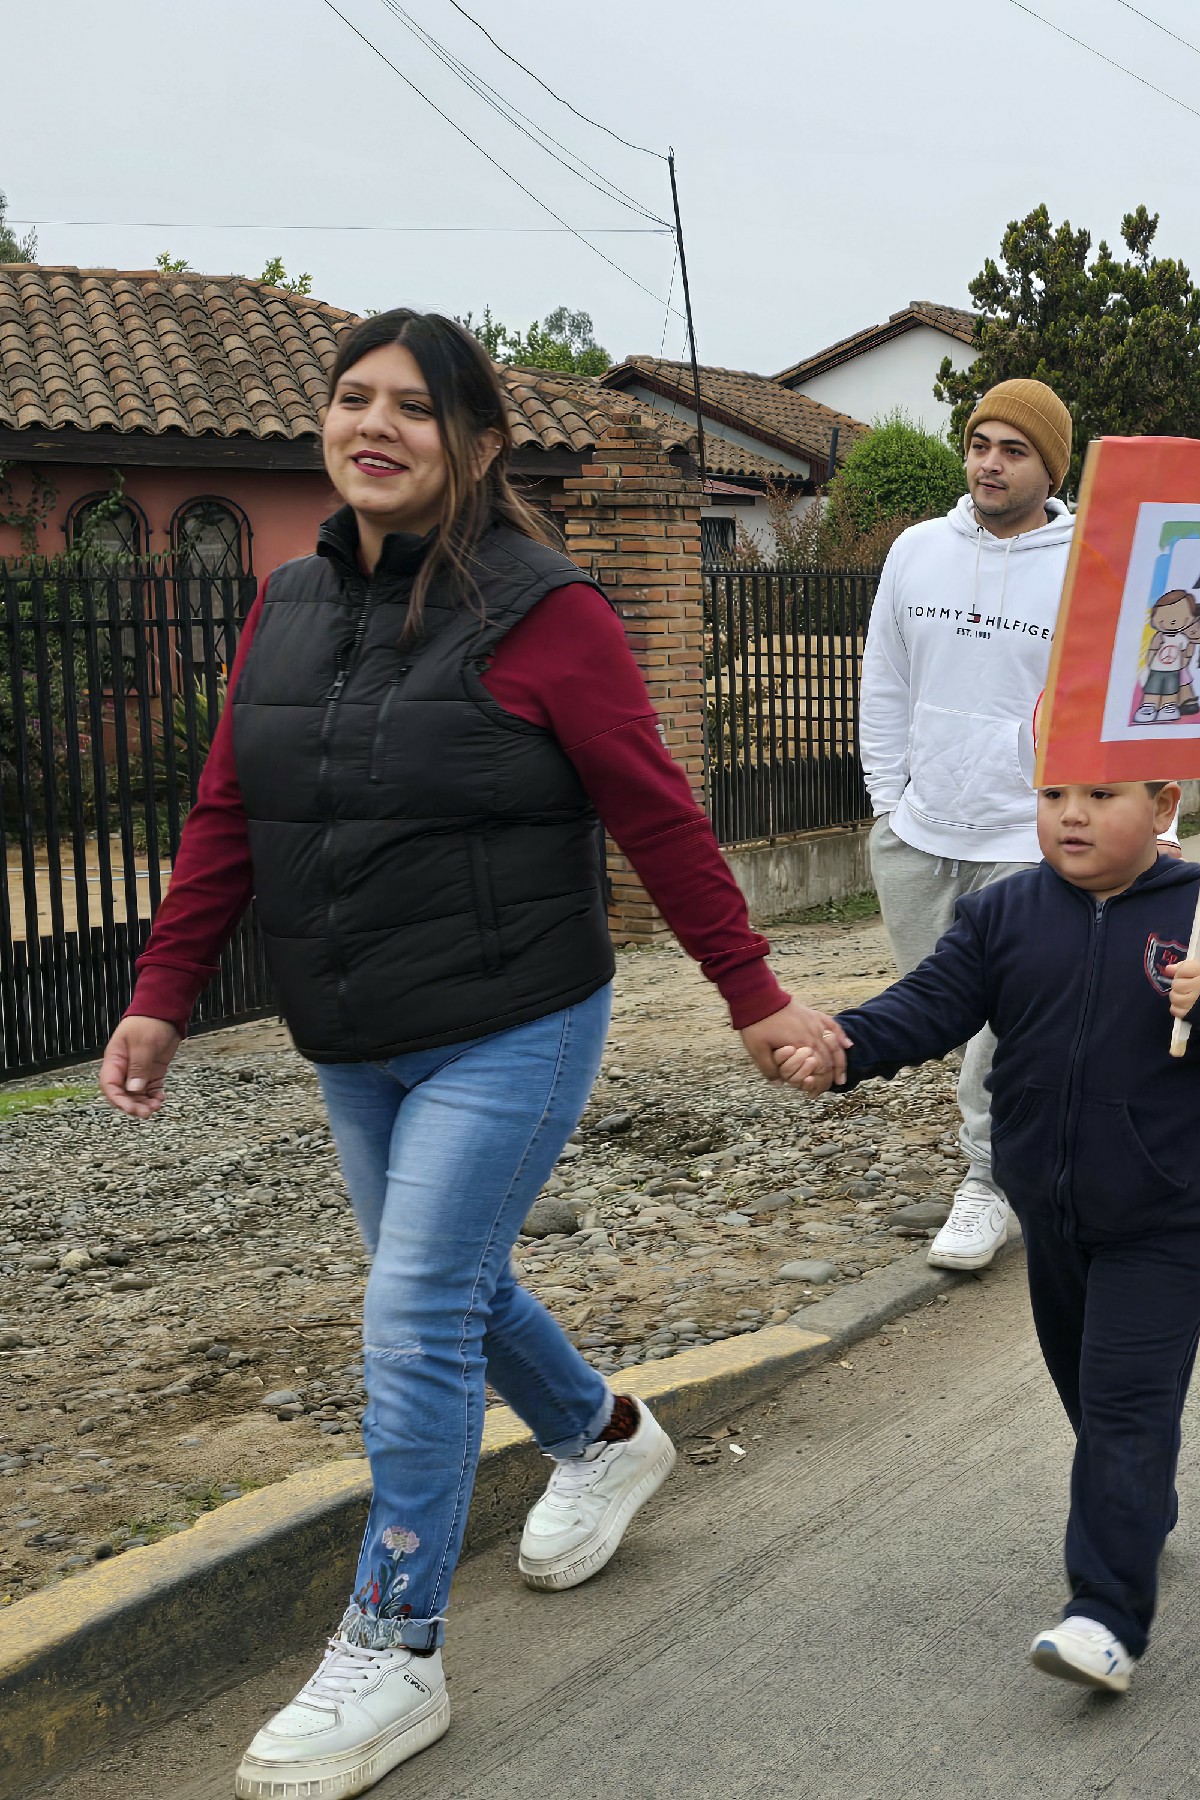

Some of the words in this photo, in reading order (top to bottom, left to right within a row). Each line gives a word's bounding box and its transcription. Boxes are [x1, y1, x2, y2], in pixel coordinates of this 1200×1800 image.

[908, 606, 963, 620] TOMMY
[985, 615, 1056, 641] HILFIGE
[956, 627, 972, 637] EST.
